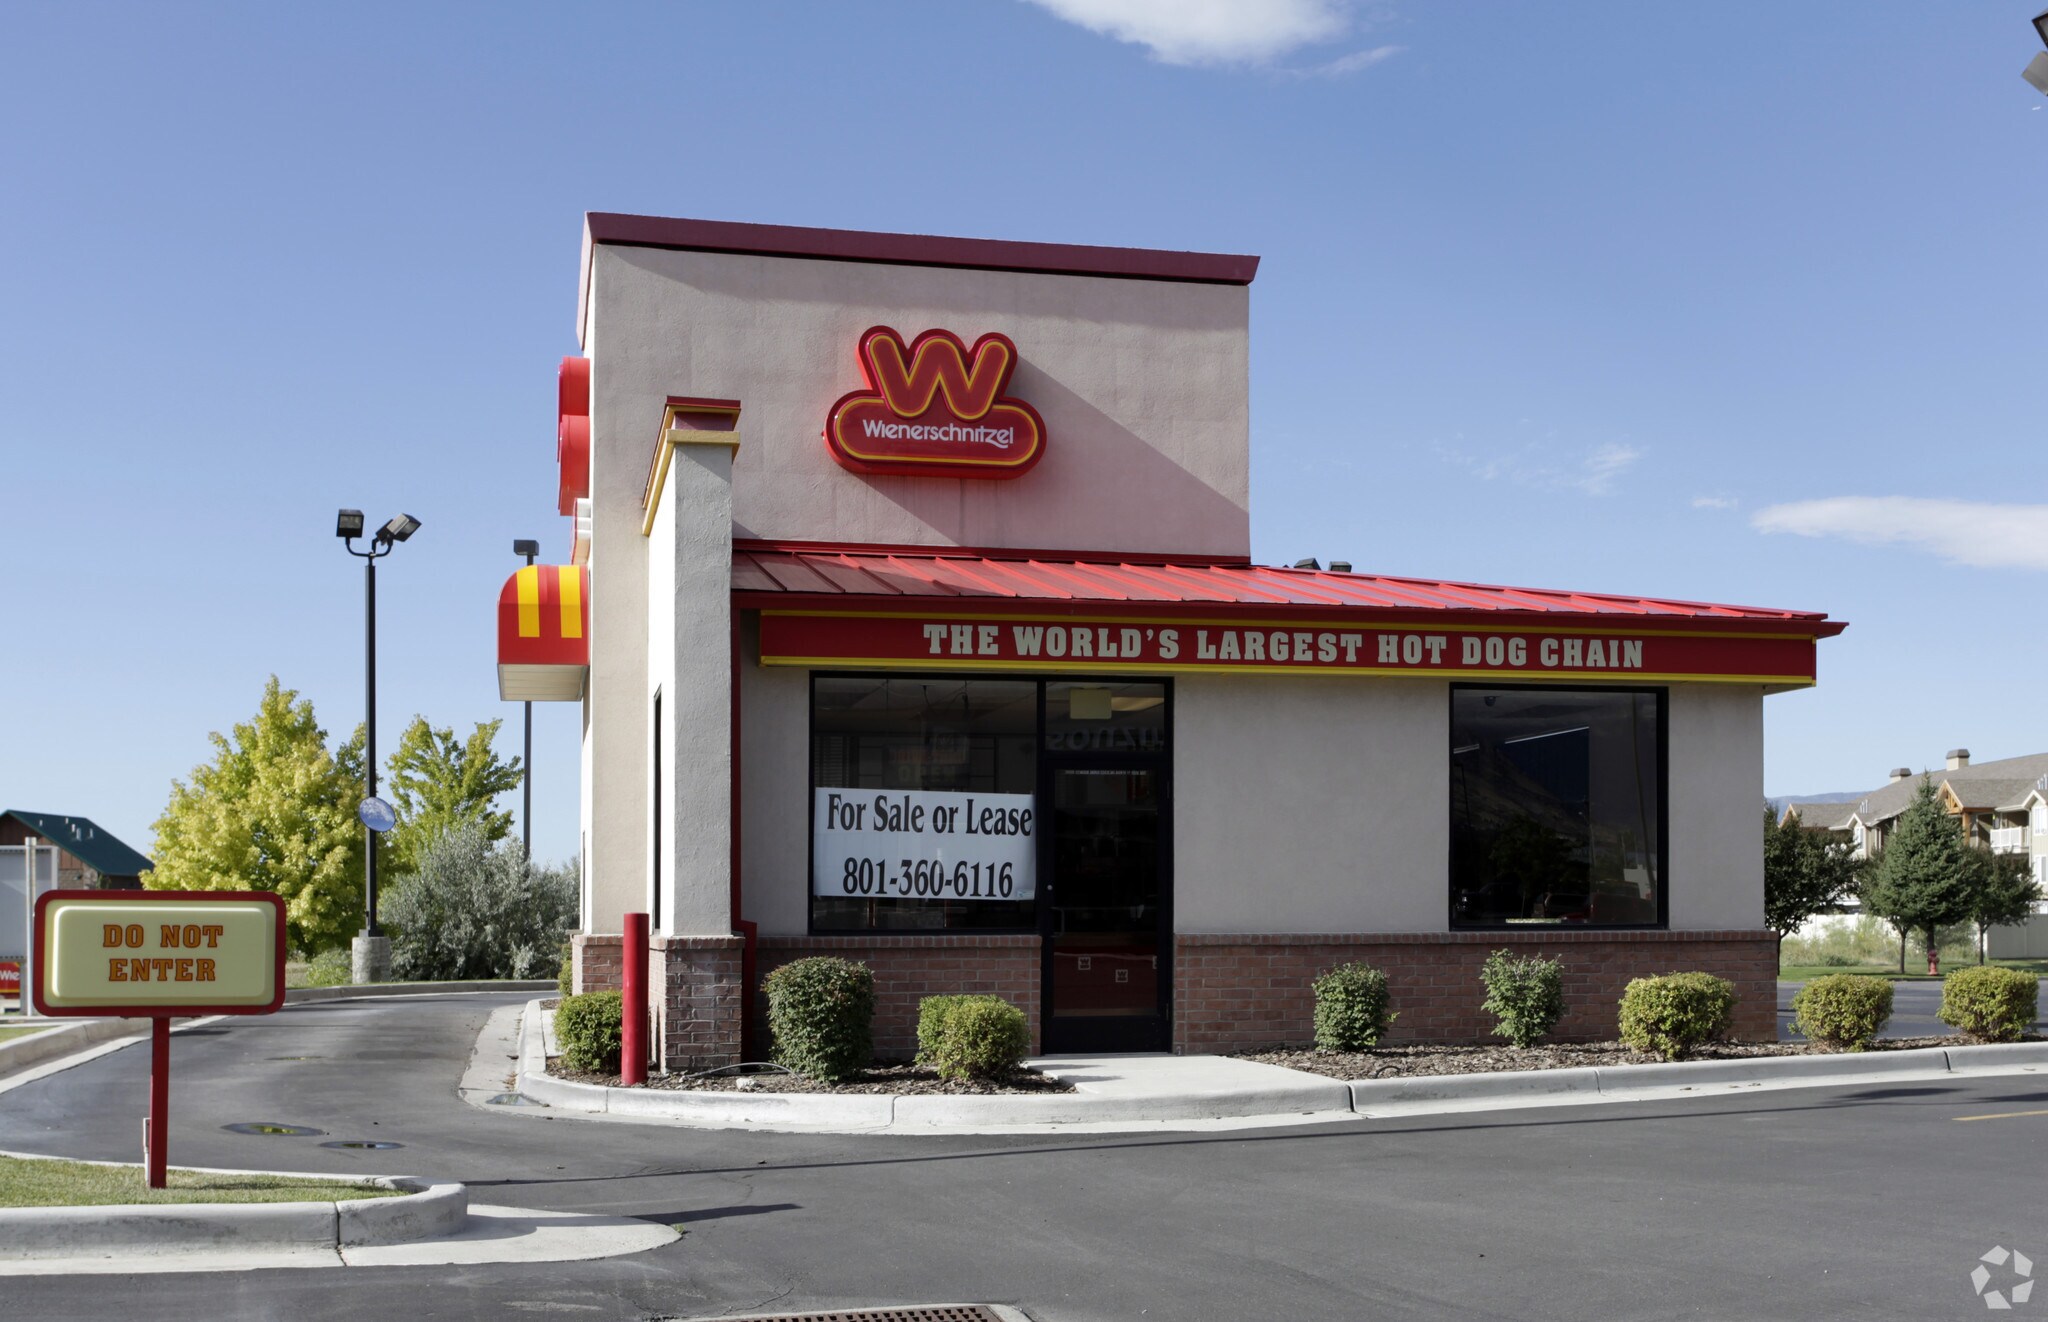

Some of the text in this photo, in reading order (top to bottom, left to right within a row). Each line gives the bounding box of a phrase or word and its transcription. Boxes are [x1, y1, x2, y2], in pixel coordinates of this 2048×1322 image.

[869, 335, 1010, 420] W
[862, 419, 1014, 449] Wienerschnitzel
[923, 624, 1643, 668] THE WORLD'S LARGEST HOT DOG CHAIN
[827, 793, 1033, 836] For Sale or Lease
[842, 857, 1013, 898] 801-360-6116
[103, 924, 224, 948] DO NOT
[108, 958, 216, 982] ENTER
